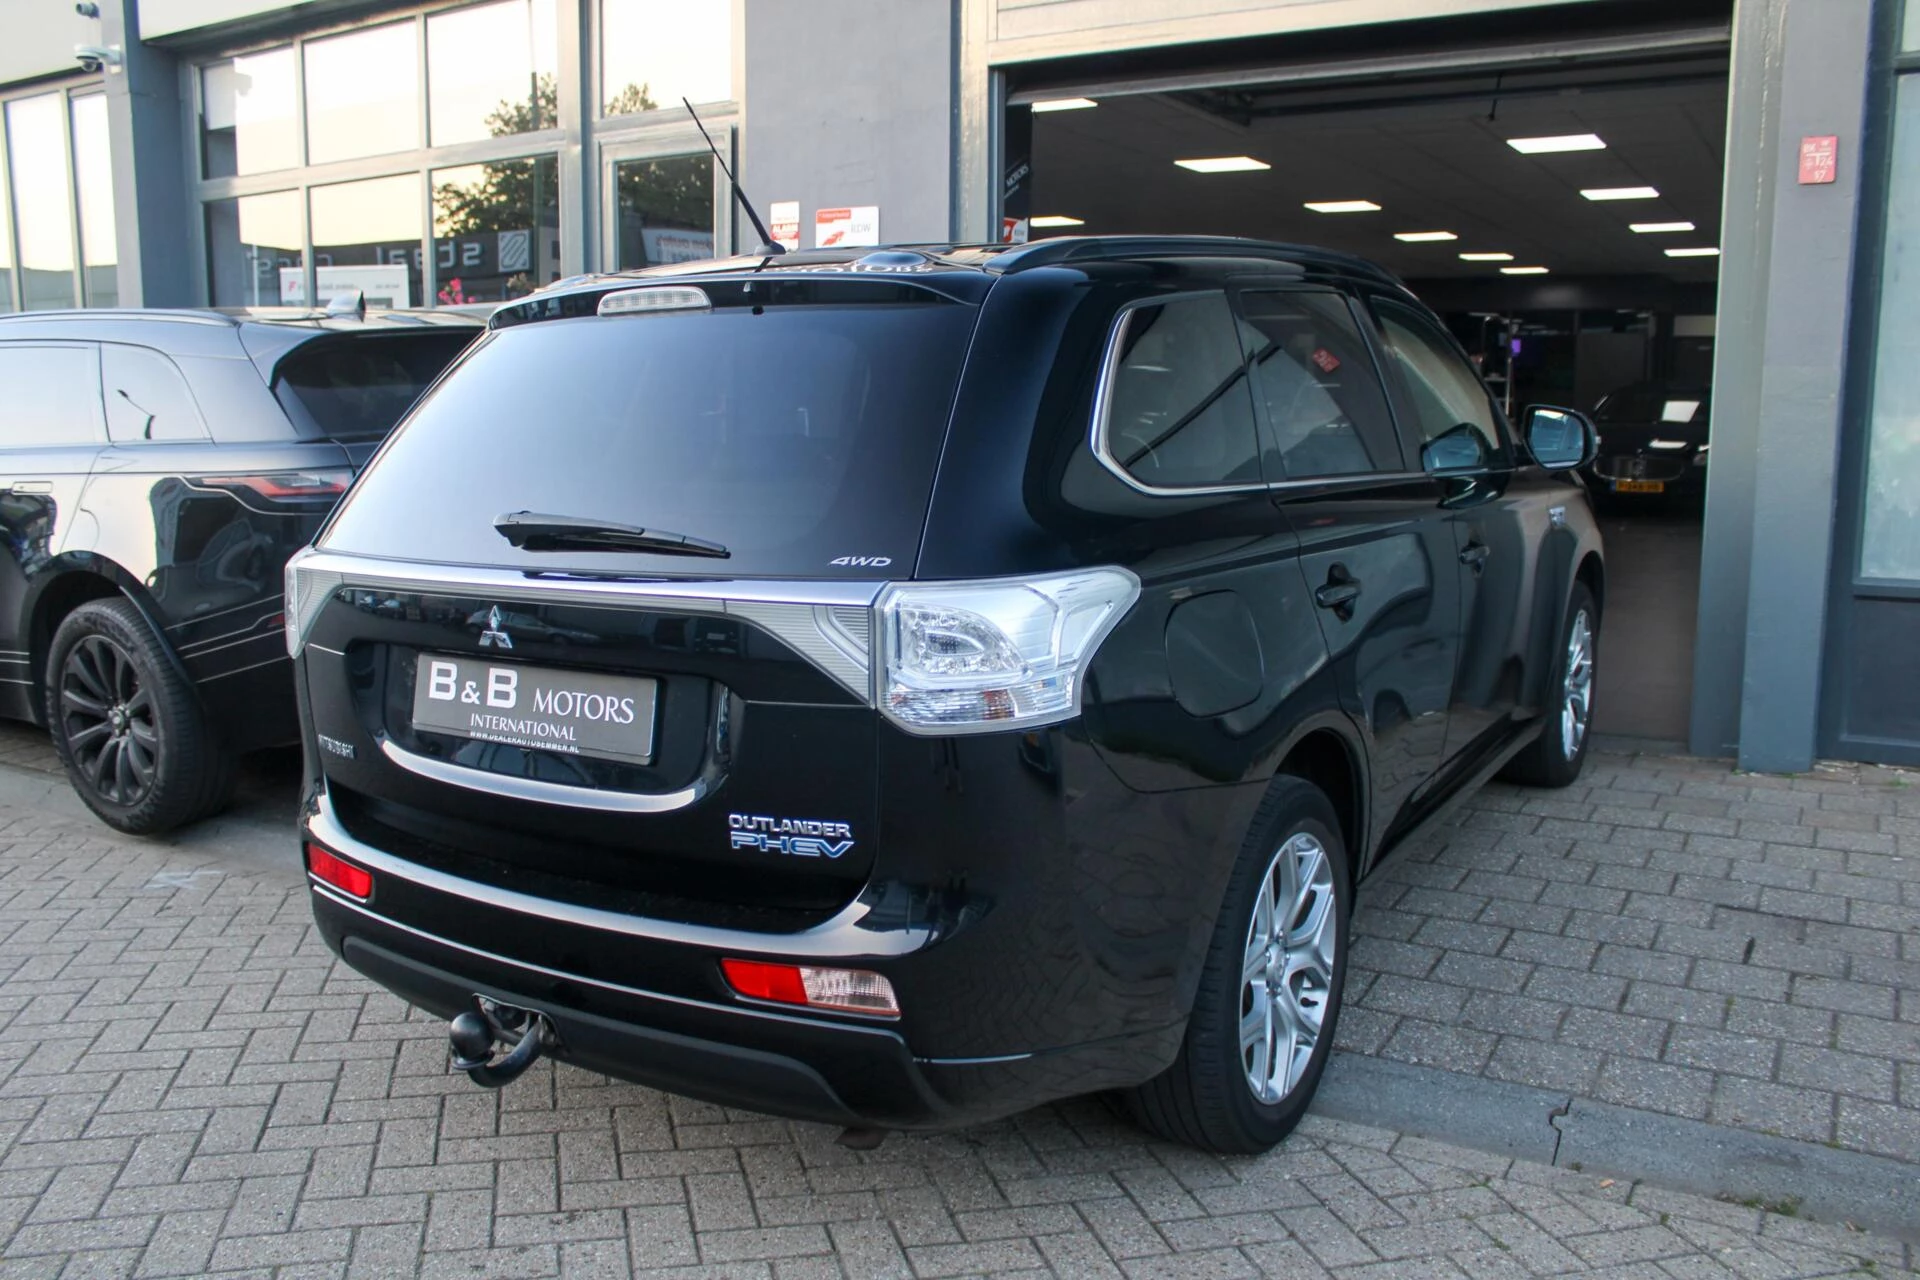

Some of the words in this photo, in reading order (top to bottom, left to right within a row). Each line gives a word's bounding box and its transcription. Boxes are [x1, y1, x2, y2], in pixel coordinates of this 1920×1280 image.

[829, 556, 892, 567] 4WD
[533, 687, 635, 724] MOTORS
[470, 713, 576, 741] INTERNATIONAL
[728, 813, 851, 838] OUTLANDER
[730, 831, 855, 858] PHEV
